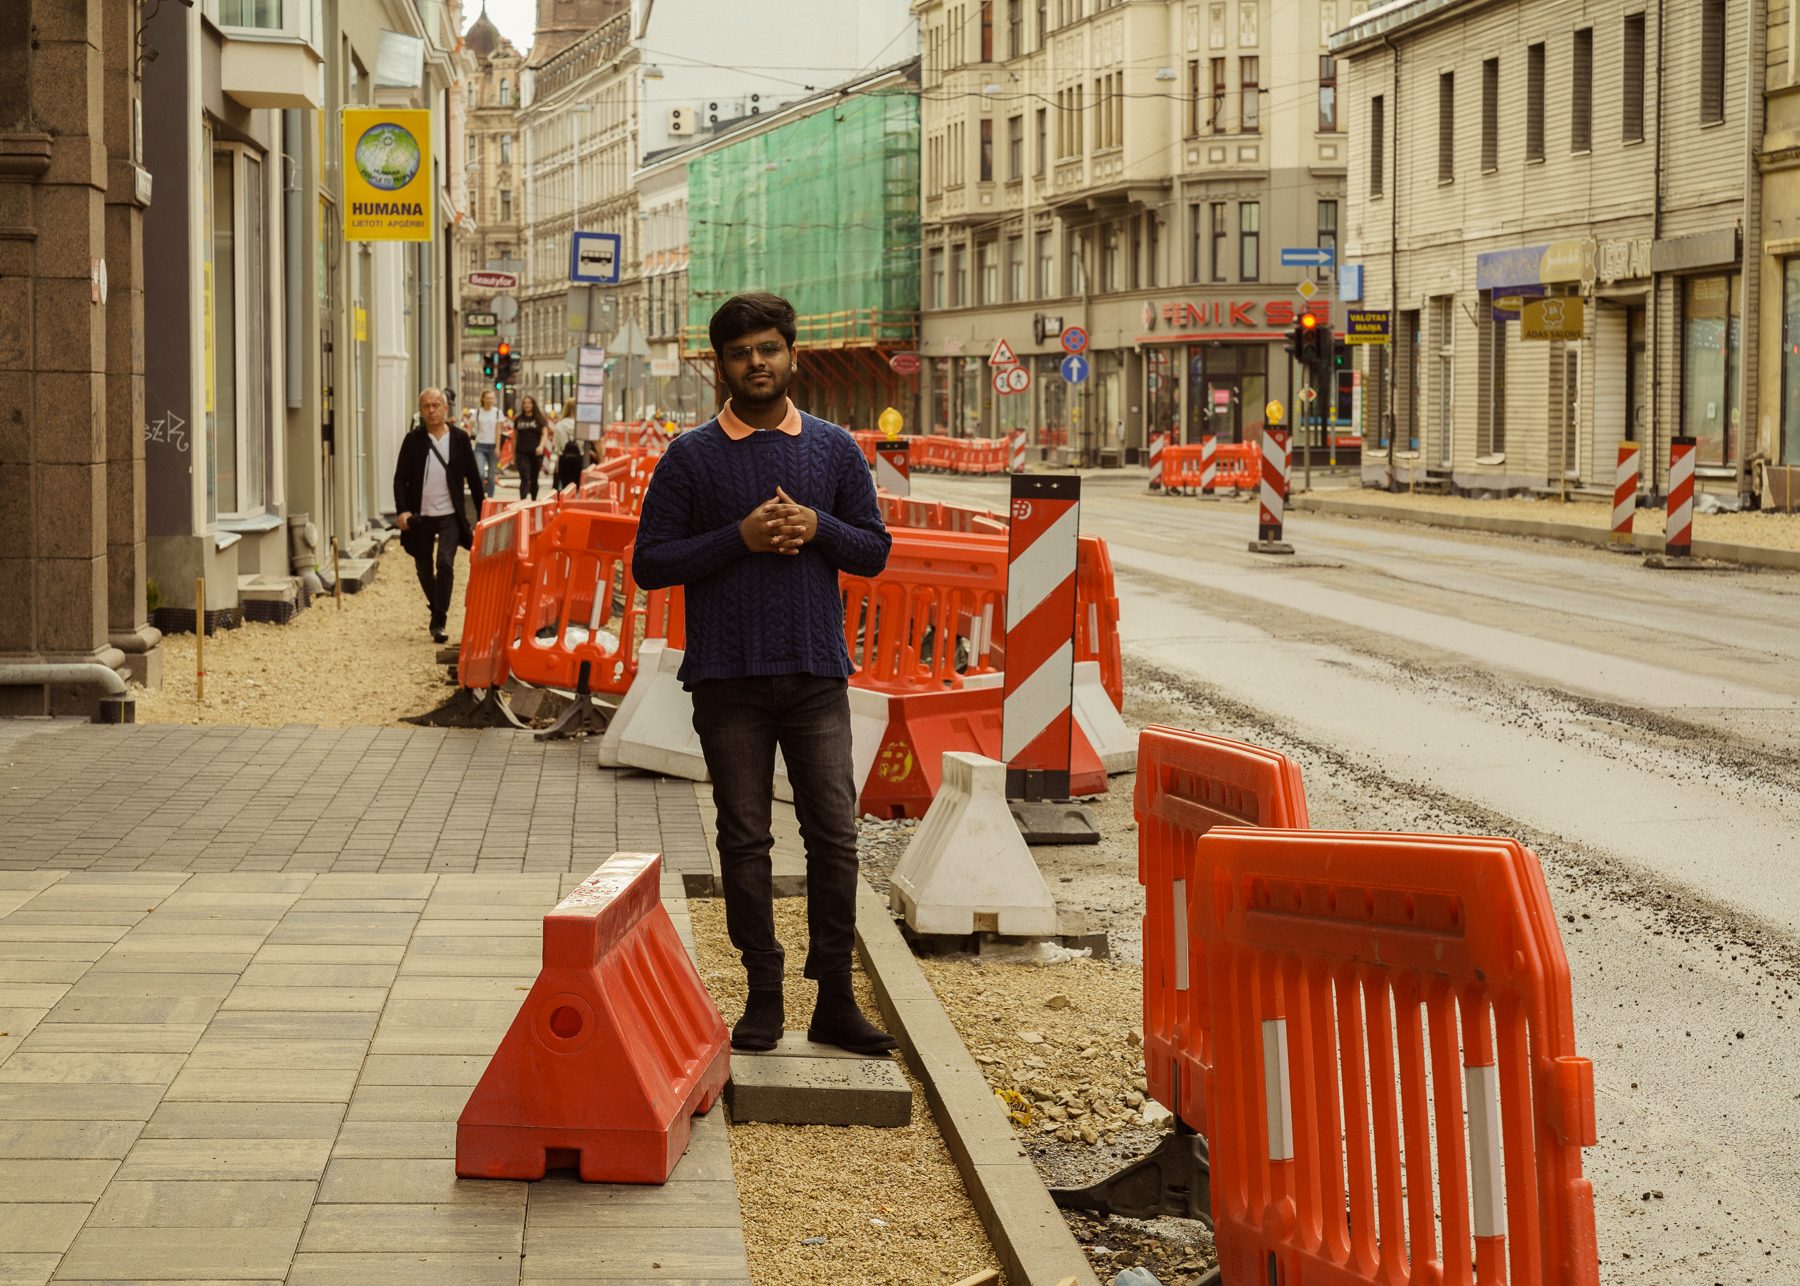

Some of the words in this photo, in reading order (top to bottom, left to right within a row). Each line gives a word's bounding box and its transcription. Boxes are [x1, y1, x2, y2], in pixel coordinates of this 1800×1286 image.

[352, 202, 423, 216] HUMANA
[468, 315, 495, 325] SEB
[1551, 329, 1582, 337] SALONS
